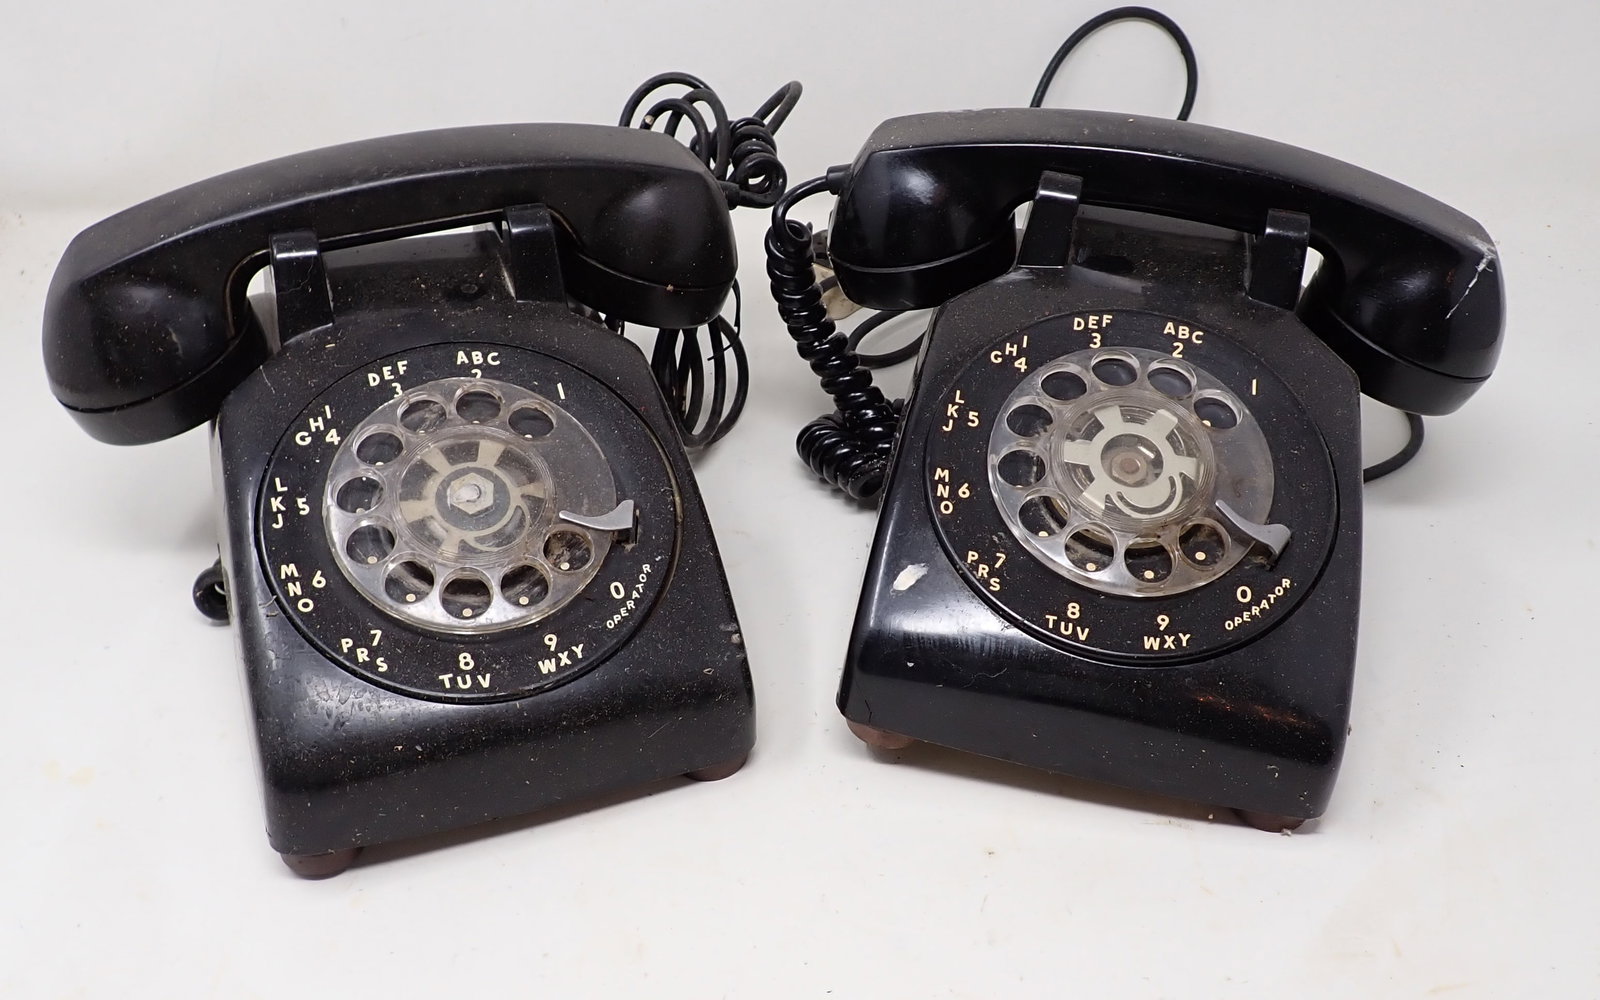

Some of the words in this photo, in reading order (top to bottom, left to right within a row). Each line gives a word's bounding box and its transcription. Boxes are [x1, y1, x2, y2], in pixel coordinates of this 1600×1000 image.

[1073, 314, 1113, 331] DEF
[1089, 332, 1102, 349] 3
[1163, 321, 1204, 347] ABC
[456, 350, 501, 366] ABC
[1171, 341, 1184, 359] 2
[367, 359, 408, 388] DEF
[1013, 356, 1028, 373] 4
[391, 382, 404, 398] 3
[967, 410, 980, 428] 5
[325, 428, 342, 446] 4
[957, 482, 971, 499] 6
[295, 495, 311, 516] 5
[994, 552, 1007, 569] 7
[311, 569, 327, 589] 6
[606, 563, 652, 629] OPERATOR
[1224, 578, 1291, 631] OPERATOR
[1066, 602, 1081, 619] 8
[1045, 614, 1090, 642] TUV
[1156, 614, 1170, 631] 9
[369, 629, 383, 647] 7
[543, 633, 558, 652] 9
[1143, 632, 1191, 651] WXY
[458, 652, 475, 671] 8
[537, 643, 584, 675] WXY
[438, 672, 491, 690] TUV
